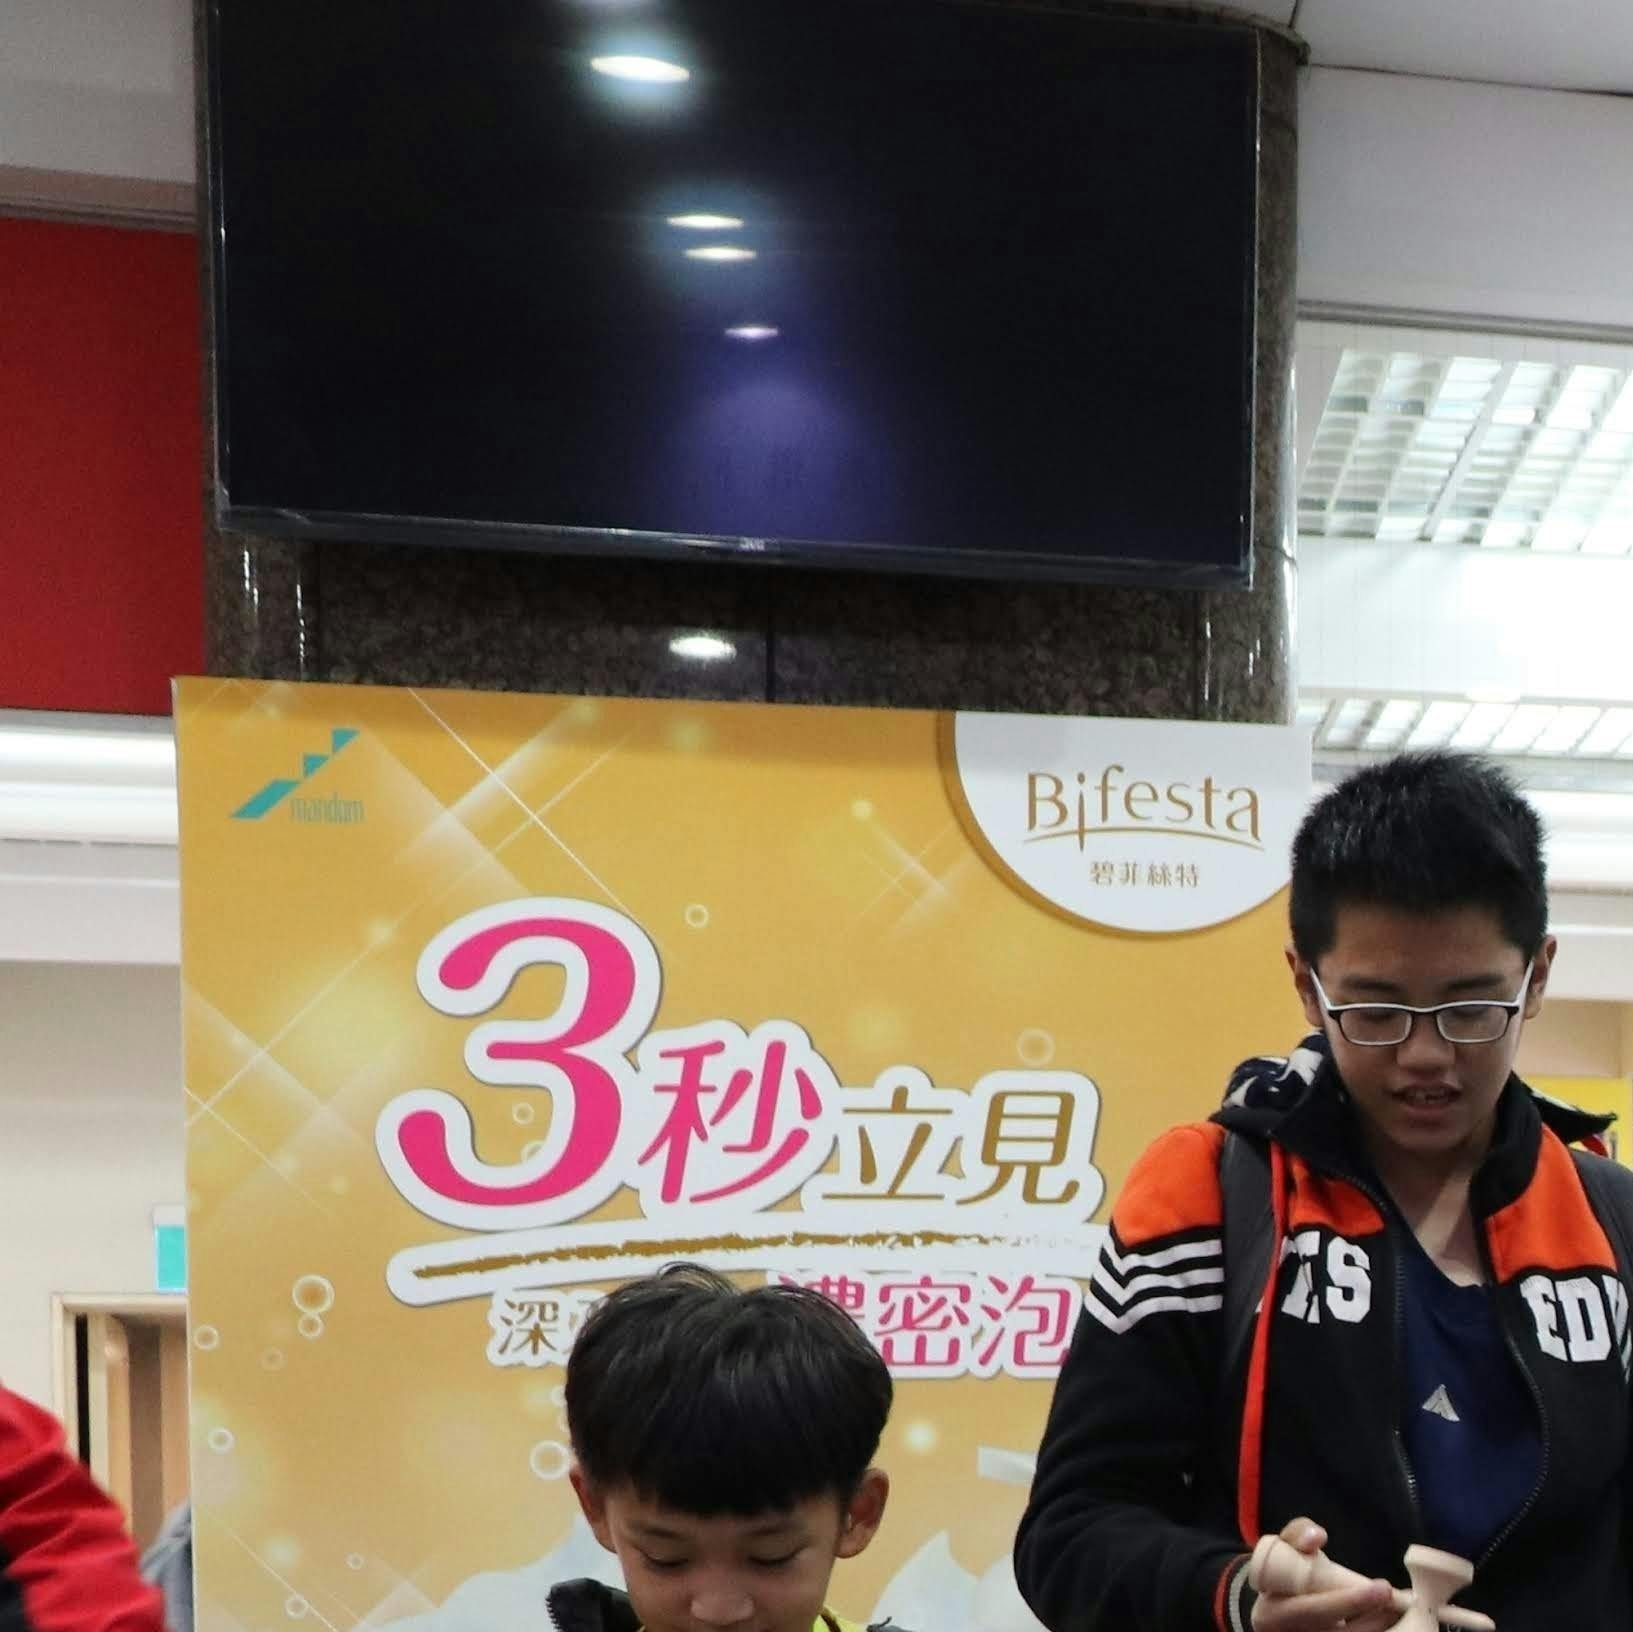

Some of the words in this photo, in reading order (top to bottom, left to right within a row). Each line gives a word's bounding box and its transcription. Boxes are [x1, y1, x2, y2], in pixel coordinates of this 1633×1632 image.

[1025, 764, 1262, 851] Bifesta
[398, 917, 1080, 1207] 3秒立見
